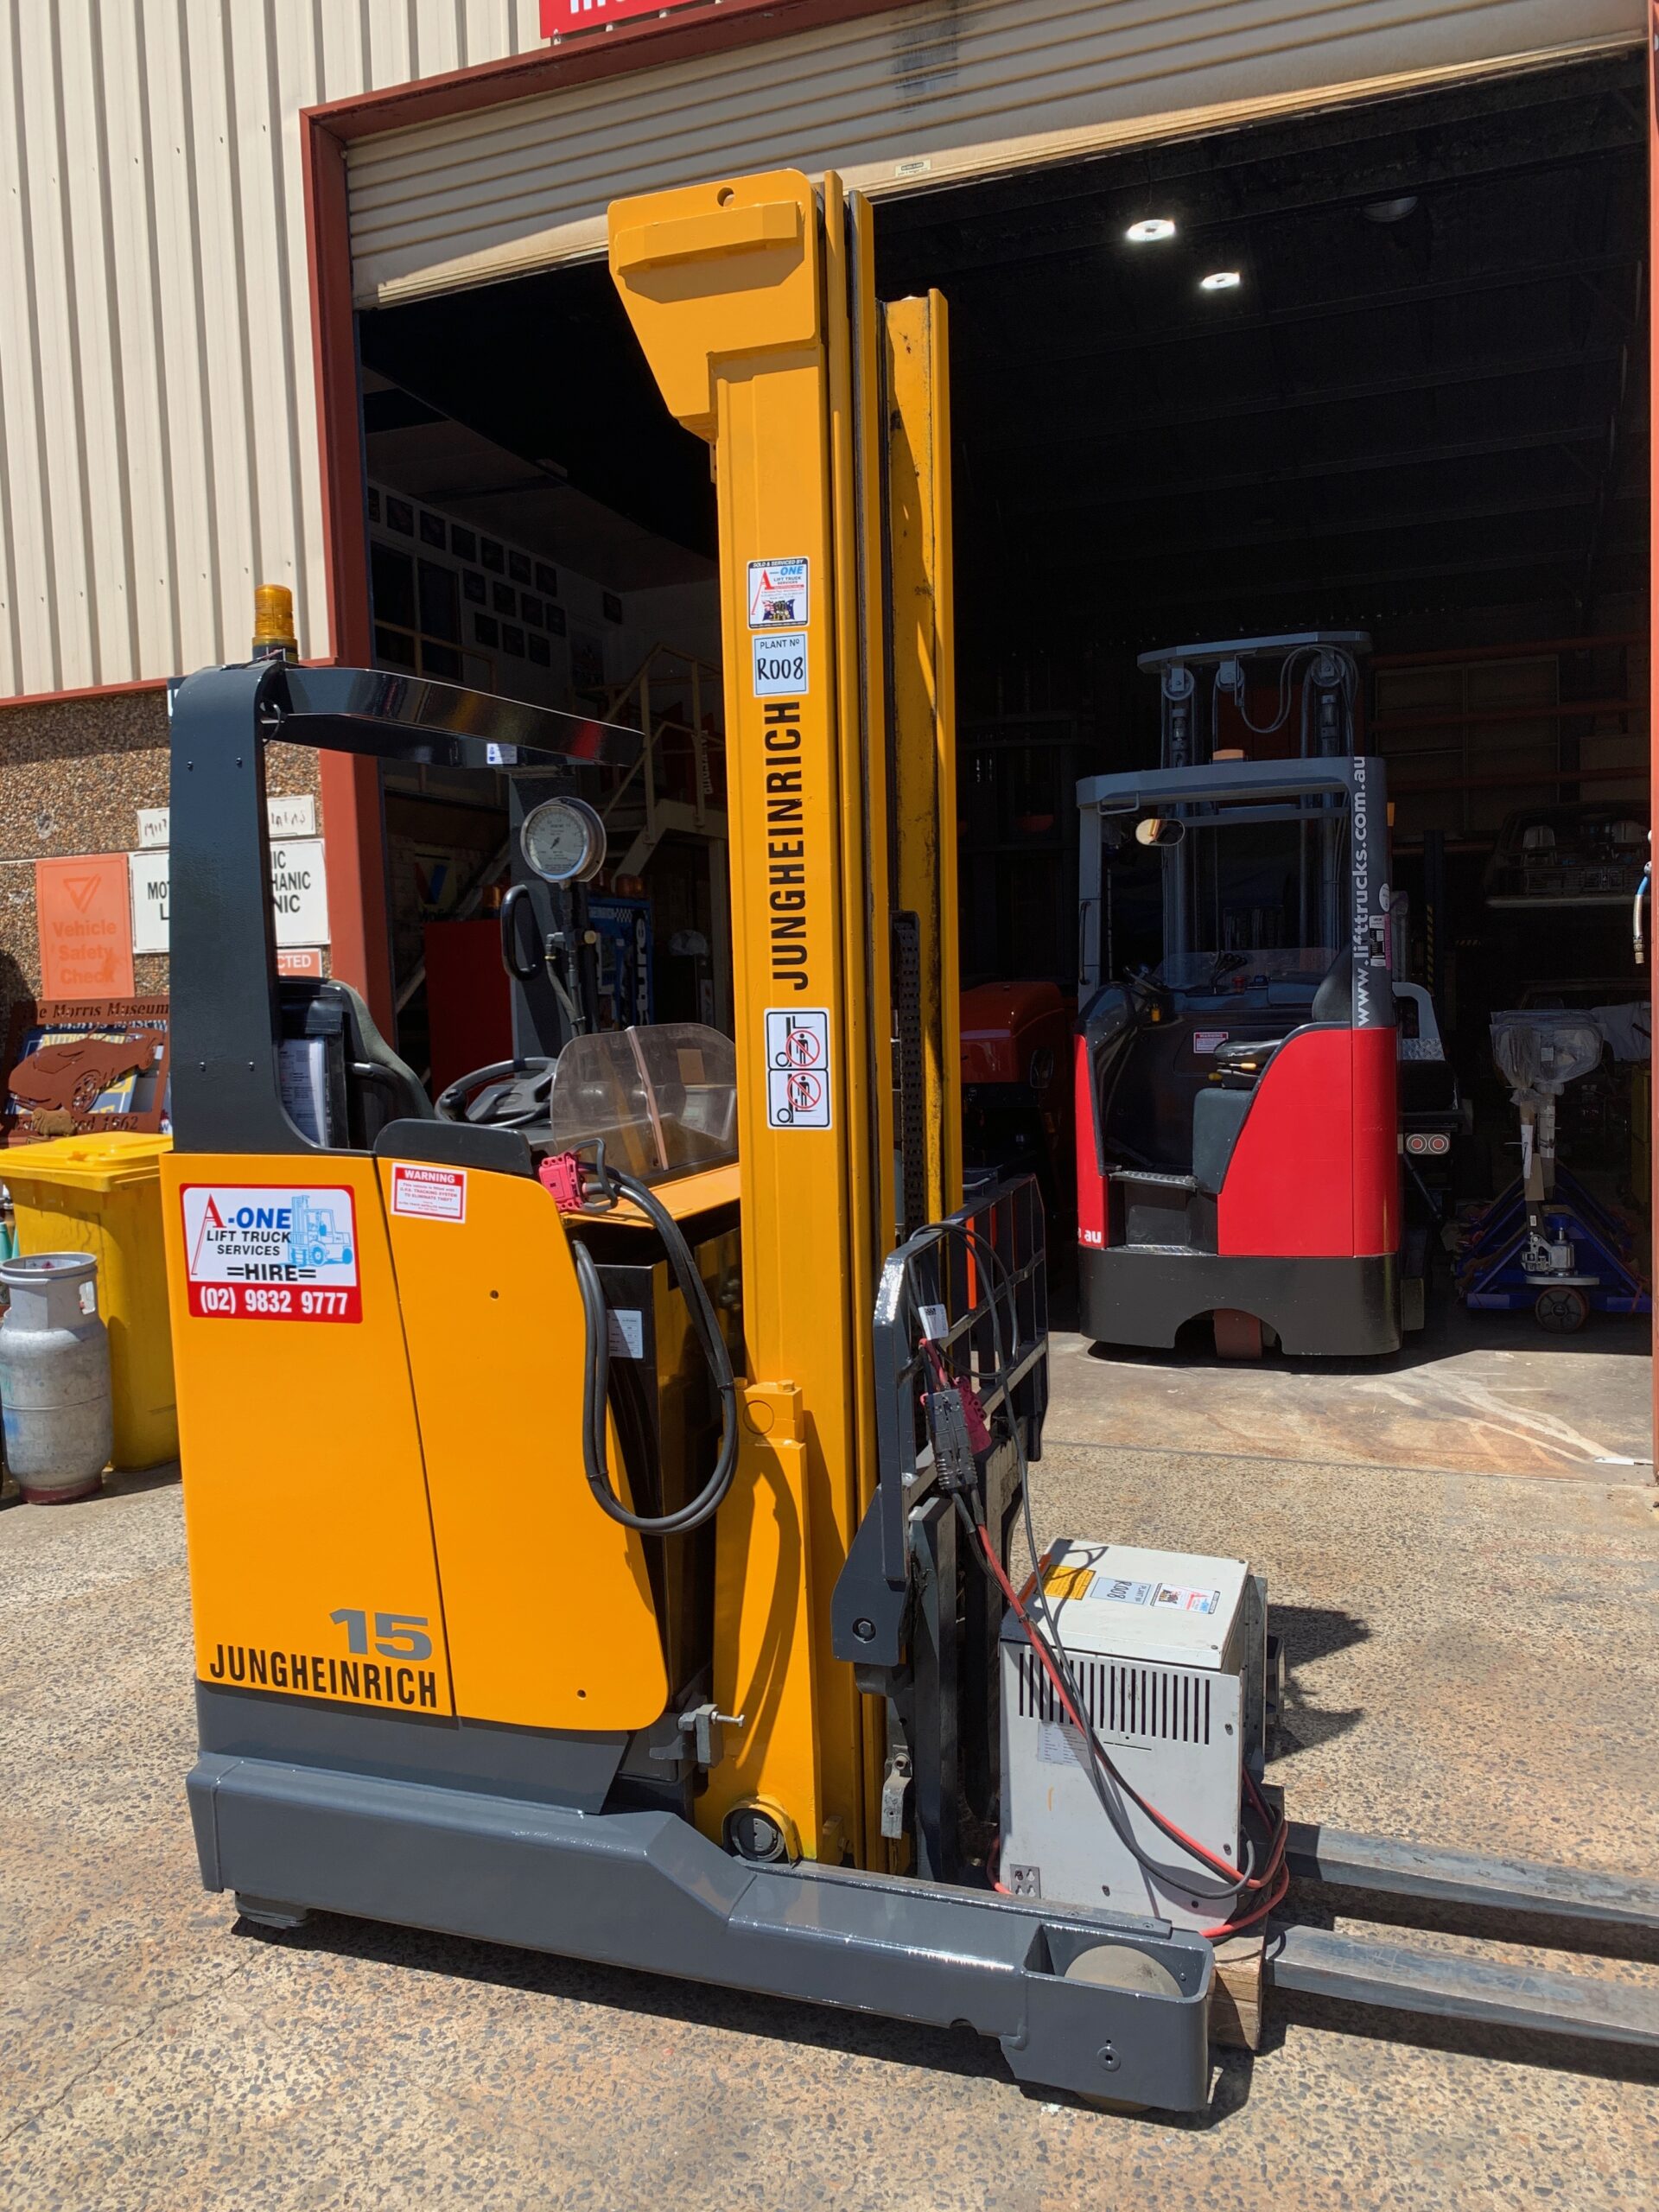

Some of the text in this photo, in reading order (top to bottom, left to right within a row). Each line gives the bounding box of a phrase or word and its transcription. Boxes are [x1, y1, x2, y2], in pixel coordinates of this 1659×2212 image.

[760, 640, 787, 649] PLANT
[757, 657, 804, 681] R008
[764, 702, 809, 991] JUNGHEINRICH
[1352, 757, 1370, 1027] www.lifttrucks.com.au
[53, 920, 118, 938] Vehicle
[58, 944, 115, 963] Safety
[60, 968, 115, 986] Check
[404, 1169, 455, 1183] WARNING
[207, 1230, 292, 1243] LIFT TRUCK
[217, 1244, 281, 1256] SERVICES
[200, 1286, 348, 1315] (02) 9832 9777
[329, 1608, 433, 1662] 15
[209, 1643, 437, 1708] JUNGHEINRICH
